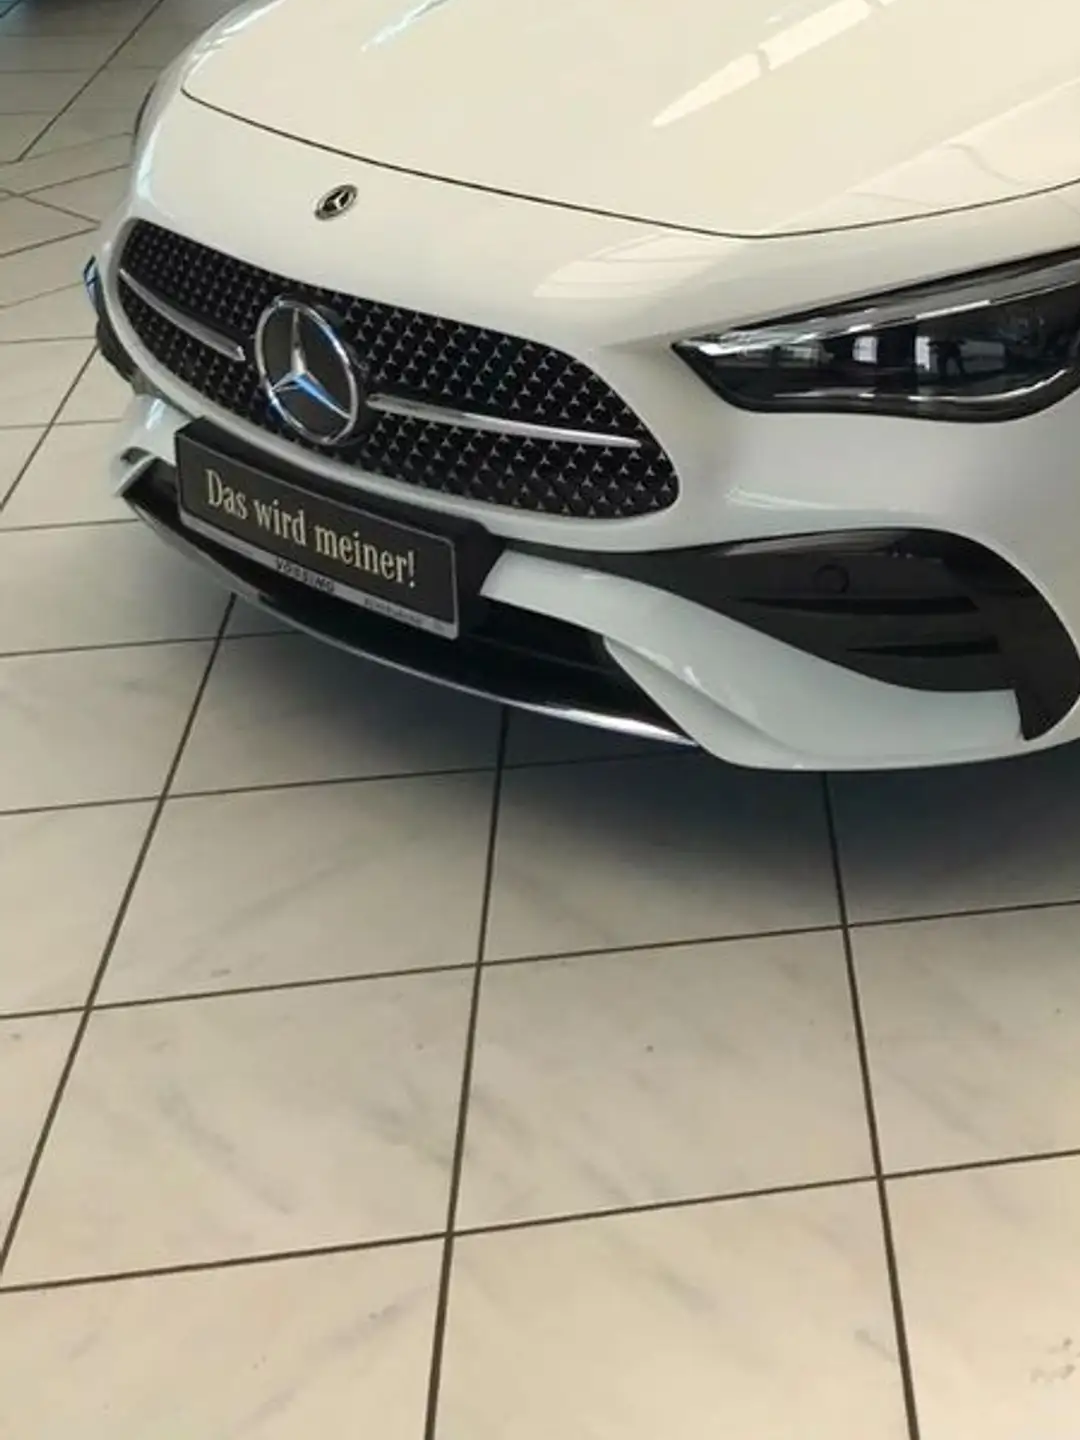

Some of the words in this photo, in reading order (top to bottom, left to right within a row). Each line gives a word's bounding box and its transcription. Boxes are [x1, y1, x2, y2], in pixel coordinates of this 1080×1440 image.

[204, 468, 248, 520] Das
[253, 498, 306, 547] wird
[314, 524, 416, 588] meiner!
